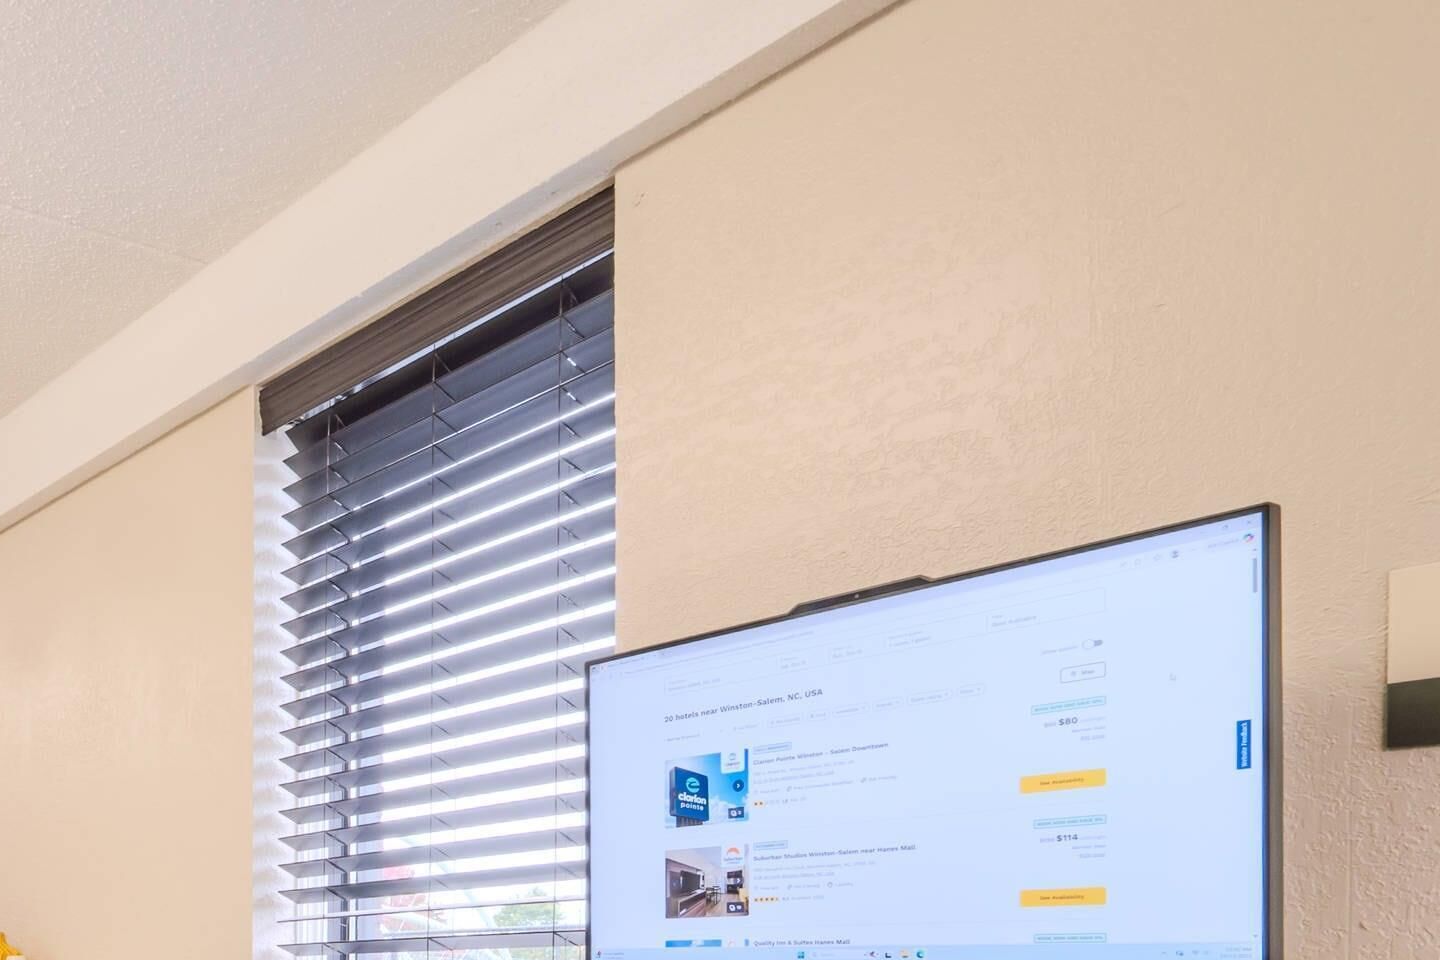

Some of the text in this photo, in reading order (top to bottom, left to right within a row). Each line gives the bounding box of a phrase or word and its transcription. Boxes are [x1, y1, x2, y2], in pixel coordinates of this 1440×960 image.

[664, 688, 823, 723] 20 hotels near Winston-Salem, NC, USA
[1058, 716, 1079, 726] $80
[678, 791, 707, 805] clarion
[680, 802, 705, 812] pointe
[1056, 834, 1079, 842] $114
